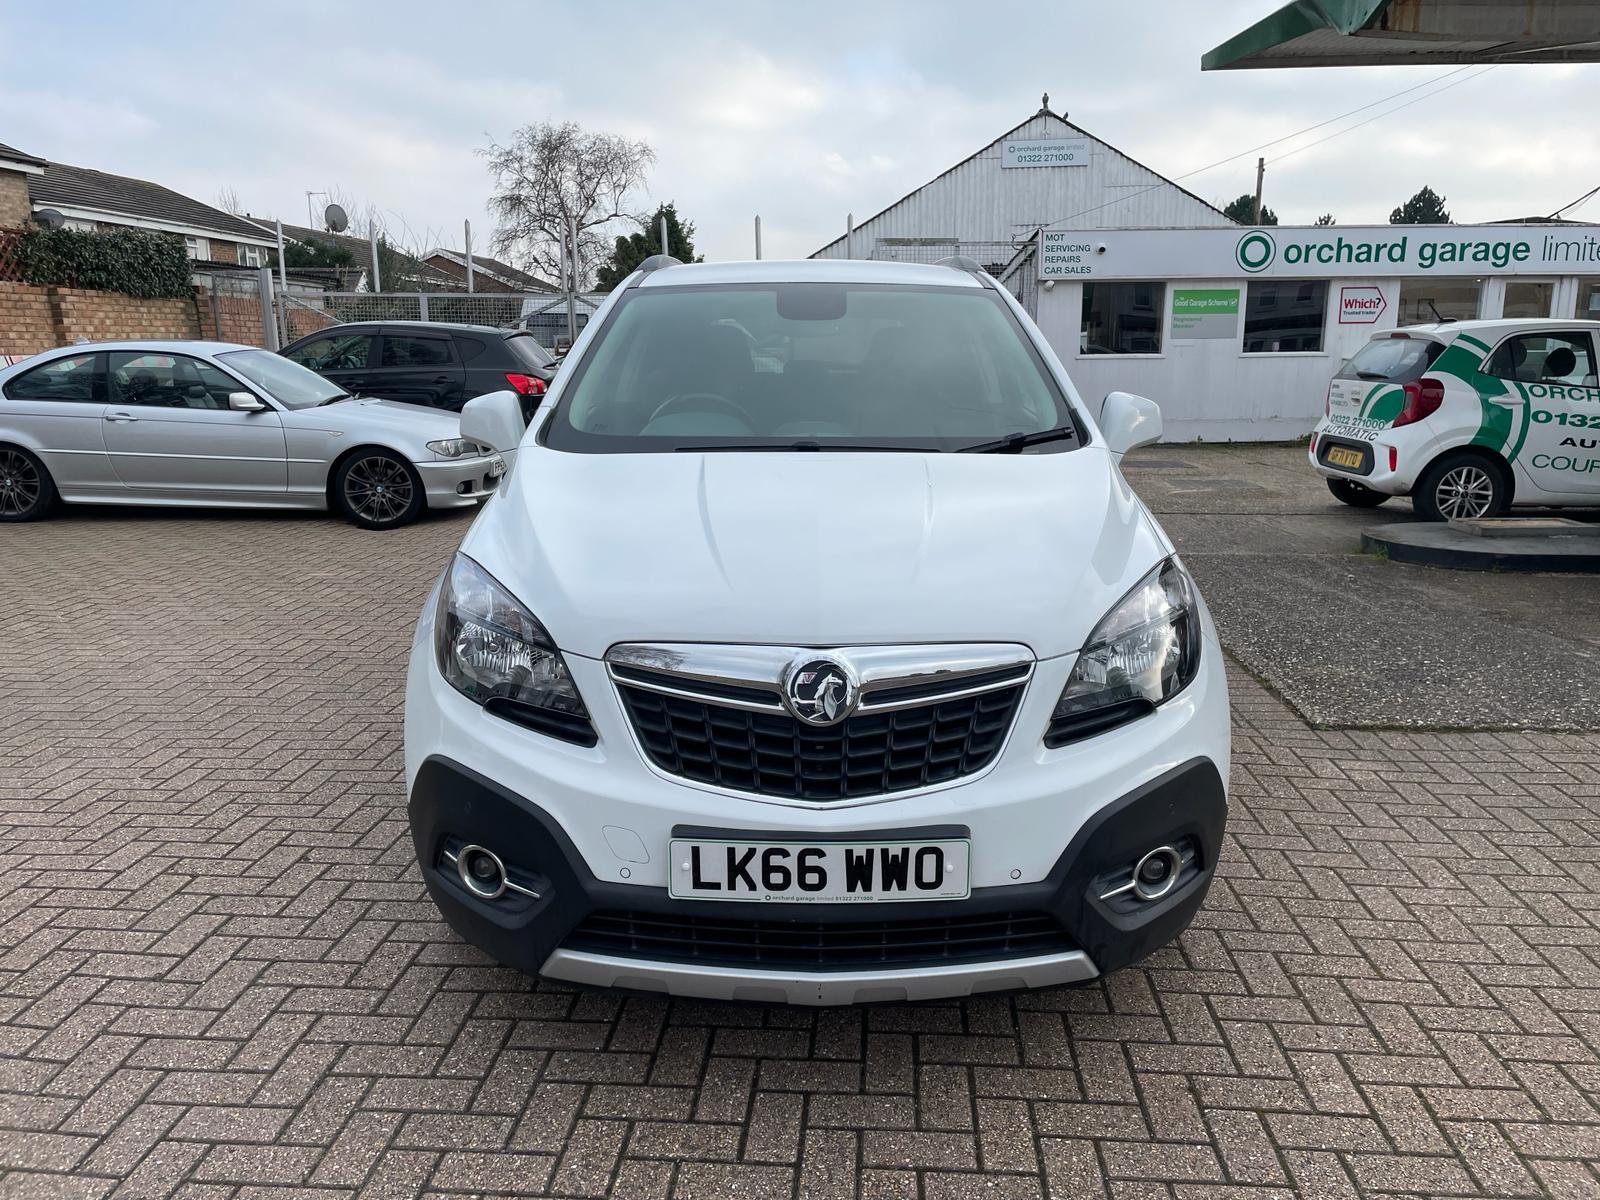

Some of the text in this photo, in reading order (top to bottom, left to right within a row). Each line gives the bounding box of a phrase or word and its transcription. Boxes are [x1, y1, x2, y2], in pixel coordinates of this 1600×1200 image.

[1017, 145, 1041, 153] orchard
[1043, 145, 1065, 153] garage
[1017, 153, 1074, 162] 01322 271000
[1045, 233, 1064, 241] MOT
[1045, 244, 1091, 252] SERVICING
[1283, 235, 1600, 269] orchard garage limit
[1045, 255, 1081, 263] REPAIRS
[1044, 266, 1092, 274] CAR SALES
[1344, 297, 1381, 309] Which?
[1528, 384, 1600, 402] ORCH
[1330, 414, 1385, 430] 01322 271000
[1321, 424, 1379, 441] AUTOMATIC
[1559, 437, 1600, 449] AU
[691, 845, 944, 893] LK66 WWO
